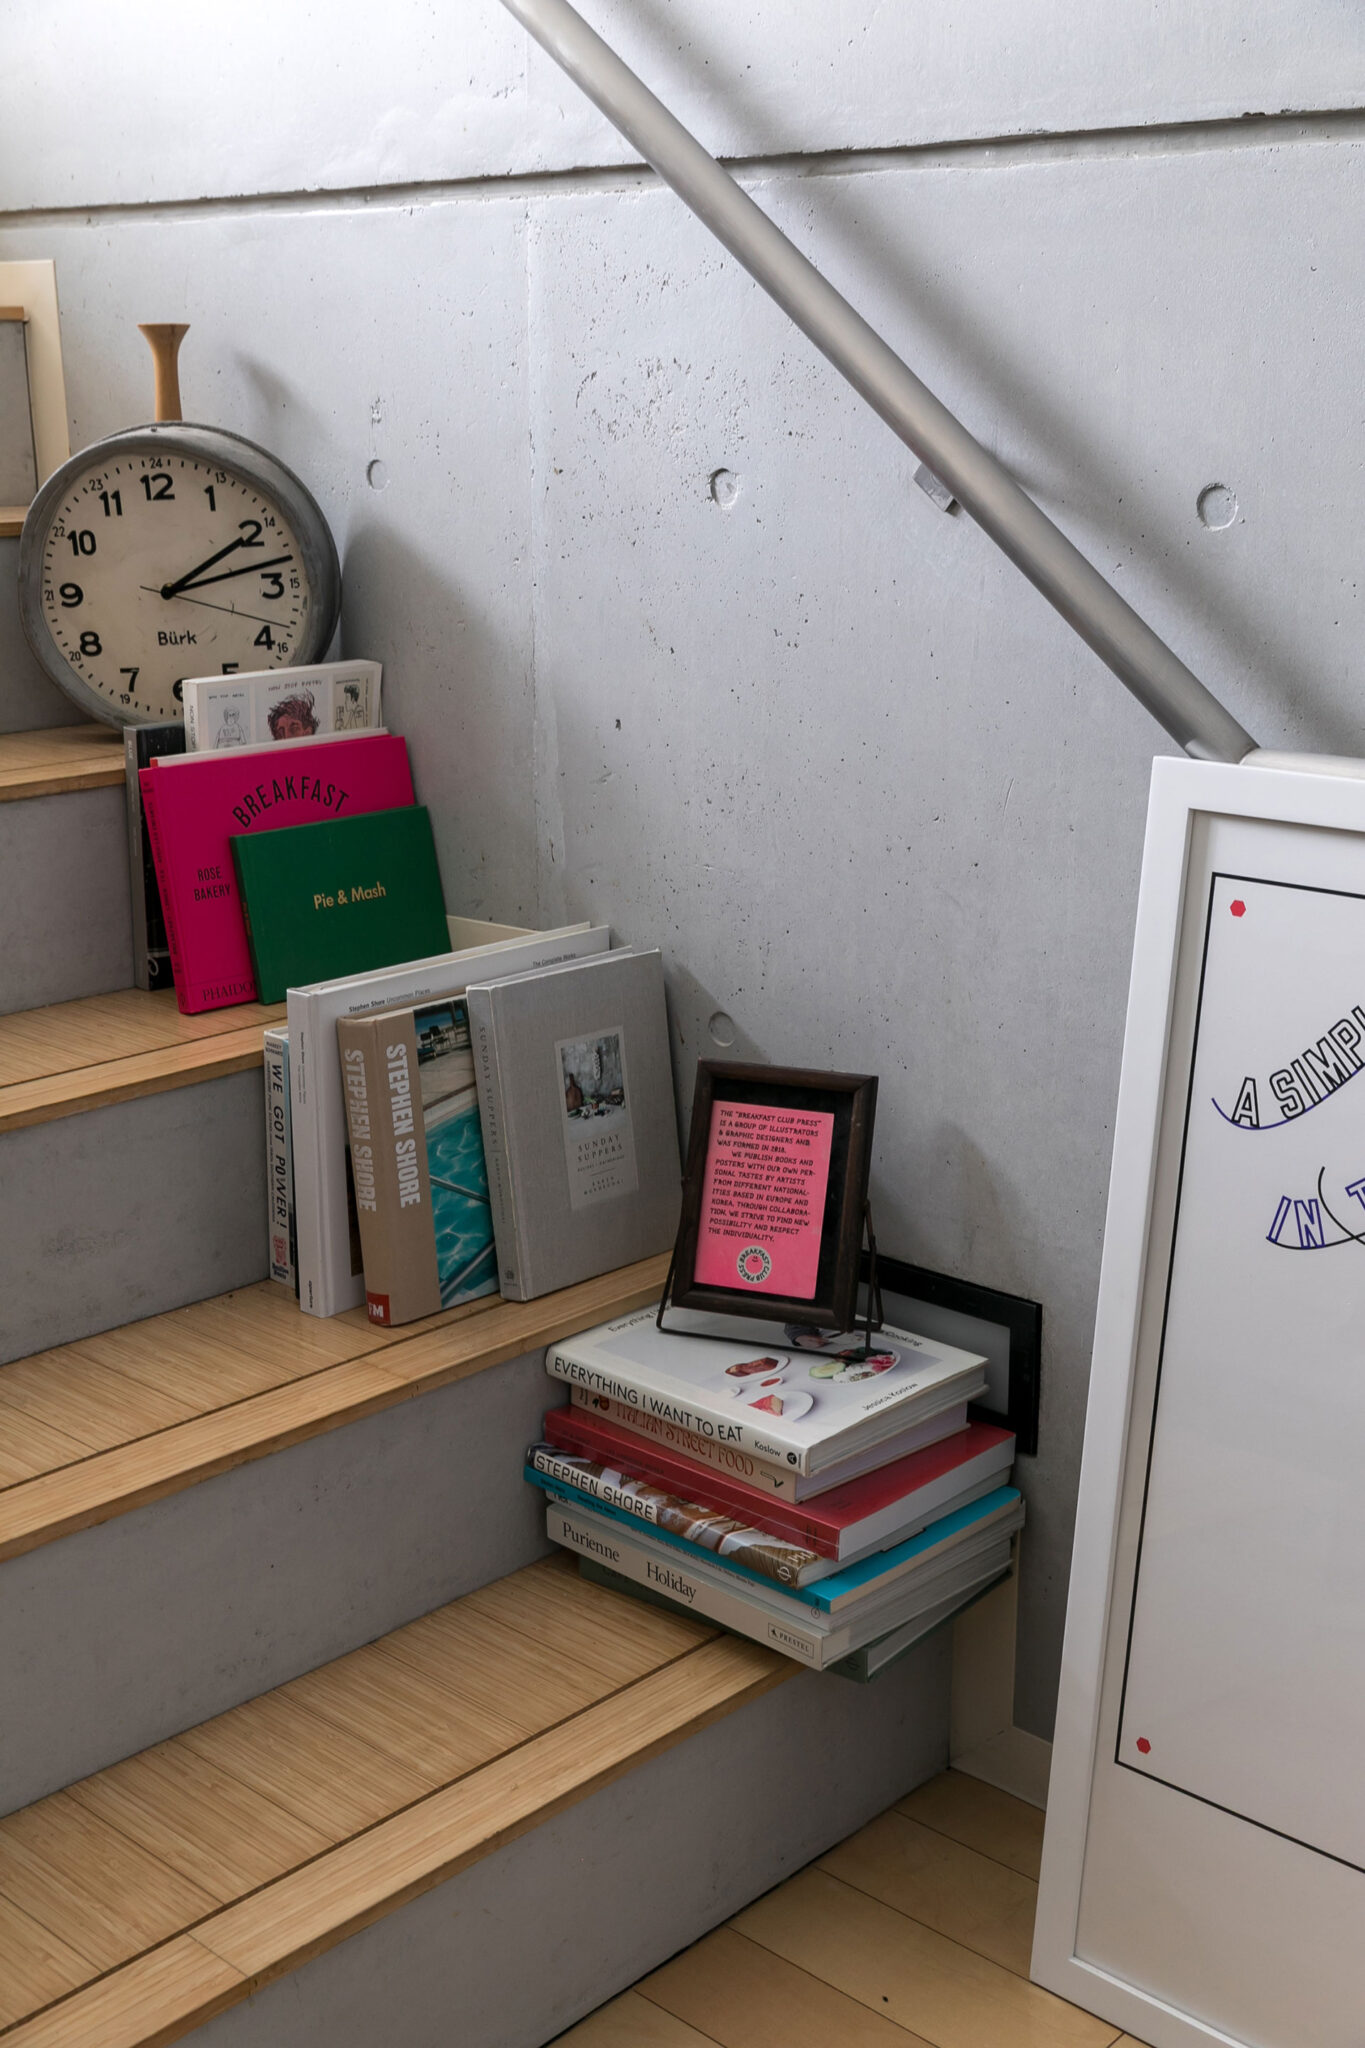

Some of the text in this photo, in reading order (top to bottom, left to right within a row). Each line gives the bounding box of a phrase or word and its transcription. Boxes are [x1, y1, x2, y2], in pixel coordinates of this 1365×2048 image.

[150, 458, 163, 469] 24
[89, 479, 103, 491] 23
[140, 473, 175, 500] 12
[215, 472, 227, 483] 13
[99, 490, 123, 516] 11
[204, 485, 216, 511] 1
[52, 526, 66, 537] 22
[264, 517, 276, 528] 14
[67, 530, 97, 556] 10
[238, 520, 265, 547] 2
[260, 572, 285, 599] 3
[290, 578, 300, 589] 15
[45, 590, 54, 601] 21
[59, 583, 83, 608] 9
[80, 631, 103, 656] 8
[157, 631, 198, 646] Bürk
[253, 625, 276, 650] 4
[69, 650, 81, 661] 20
[277, 642, 289, 653] 16
[120, 667, 140, 692] 7
[120, 694, 131, 704] 19
[232, 775, 350, 828] BREAKFAST
[197, 866, 222, 881] ROSE
[194, 884, 231, 901] BAKERY
[313, 881, 386, 910] Pie & Mash
[271, 1064, 283, 1094] WE
[479, 1026, 499, 1146] SUNDAY SUPPERS
[1231, 1076, 1260, 1129] A
[274, 1105, 285, 1144] GOT
[386, 1043, 420, 1209] STEPHEN SHORE
[720, 1110, 733, 1118] THE
[777, 1116, 795, 1124] CLUB
[344, 1048, 377, 1213] STEPHEN SHORE
[725, 1130, 754, 1140] GRAPHIC
[756, 1134, 793, 1144] DESIGNERS
[796, 1138, 811, 1146] AND
[734, 1121, 756, 1130] GROUP
[769, 1125, 819, 1137] ILLUSTRATORS
[577, 1143, 623, 1163] SUPPERS
[578, 1134, 620, 1153] SUNDAY
[717, 1139, 731, 1147] WAS
[732, 1141, 758, 1151] FORMED
[760, 1144, 769, 1152] IN
[715, 1159, 745, 1169] POSTERS
[747, 1163, 765, 1171] WITH
[766, 1165, 781, 1173] OUR
[782, 1166, 798, 1175] OWN
[731, 1150, 814, 1167] WE PUBLISH BOOKS AND
[713, 1179, 732, 1187] FROM
[733, 1181, 771, 1192] DIFFERENT
[714, 1169, 735, 1178] SONAL
[738, 1172, 763, 1181] TASTES
[776, 1176, 806, 1186] ARTISTS
[276, 1154, 288, 1229] POWER!
[712, 1188, 731, 1197] ITIES
[733, 1191, 754, 1200] BASED
[765, 1195, 792, 1204] EUROPE
[794, 1198, 809, 1206] AND
[737, 1201, 768, 1211] THROUGH
[709, 1218, 800, 1235] POSSIBILITY AND RESPECT
[729, 1210, 739, 1218] WE
[740, 1212, 764, 1221] STRIVE
[776, 1216, 793, 1224] FIND
[794, 1218, 810, 1226] NEW
[1266, 1195, 1326, 1251] IN
[708, 1227, 720, 1235] THE
[738, 1247, 770, 1282] BREAKFAST CLUB PRESS
[554, 1357, 743, 1442] EVERYTHING I WANT TO EAT
[616, 1402, 755, 1476] ITALIAN STREET FOOD
[754, 1439, 781, 1457] Koslow
[536, 1455, 599, 1496] STEPHEN
[603, 1486, 654, 1520] SHORE
[562, 1521, 620, 1562] Purienne
[646, 1561, 697, 1603] Holiday
[777, 1631, 811, 1653] PRESTEL
